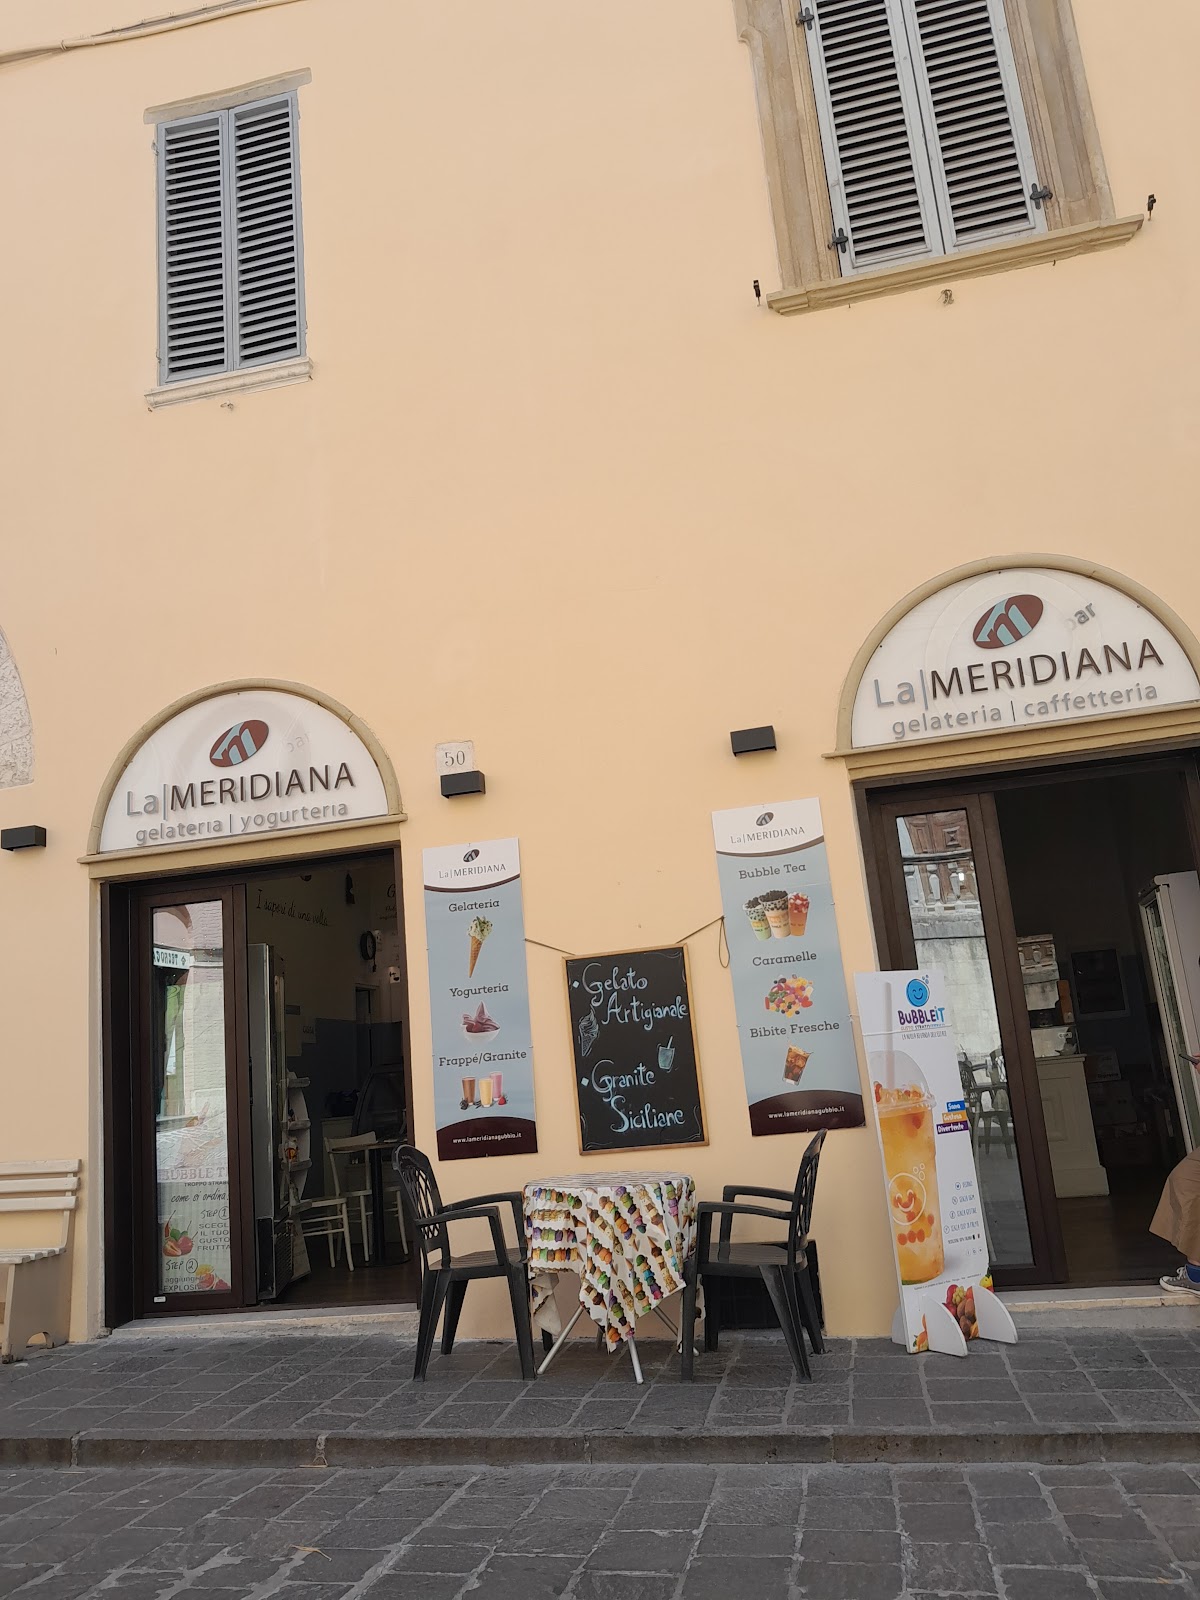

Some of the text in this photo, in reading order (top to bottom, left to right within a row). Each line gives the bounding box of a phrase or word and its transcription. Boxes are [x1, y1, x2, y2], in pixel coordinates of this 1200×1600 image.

[892, 682, 1158, 740] gelateria caffetteria
[444, 750, 466, 768] 50
[135, 802, 348, 847] gelateria yogurteria
[738, 863, 806, 880] Bubble Tea
[448, 898, 500, 913] Gelateria
[752, 951, 817, 966] Caramelle
[449, 982, 509, 999] Yogurteria
[582, 962, 648, 1007] Gelato
[601, 991, 689, 1031] Artigianale
[750, 1020, 840, 1038] Bibite Fresche
[438, 1049, 527, 1068] Frappé/Granite
[591, 1059, 656, 1102] Granite
[610, 1095, 686, 1133] Siciliane
[768, 1106, 845, 1119] www.lameridianagubbio.it
[452, 1131, 522, 1144] www.lameridianagubbio.it
[171, 1193, 190, 1203] come
[200, 1209, 218, 1219] STEP
[165, 1259, 194, 1271] STEP 2
